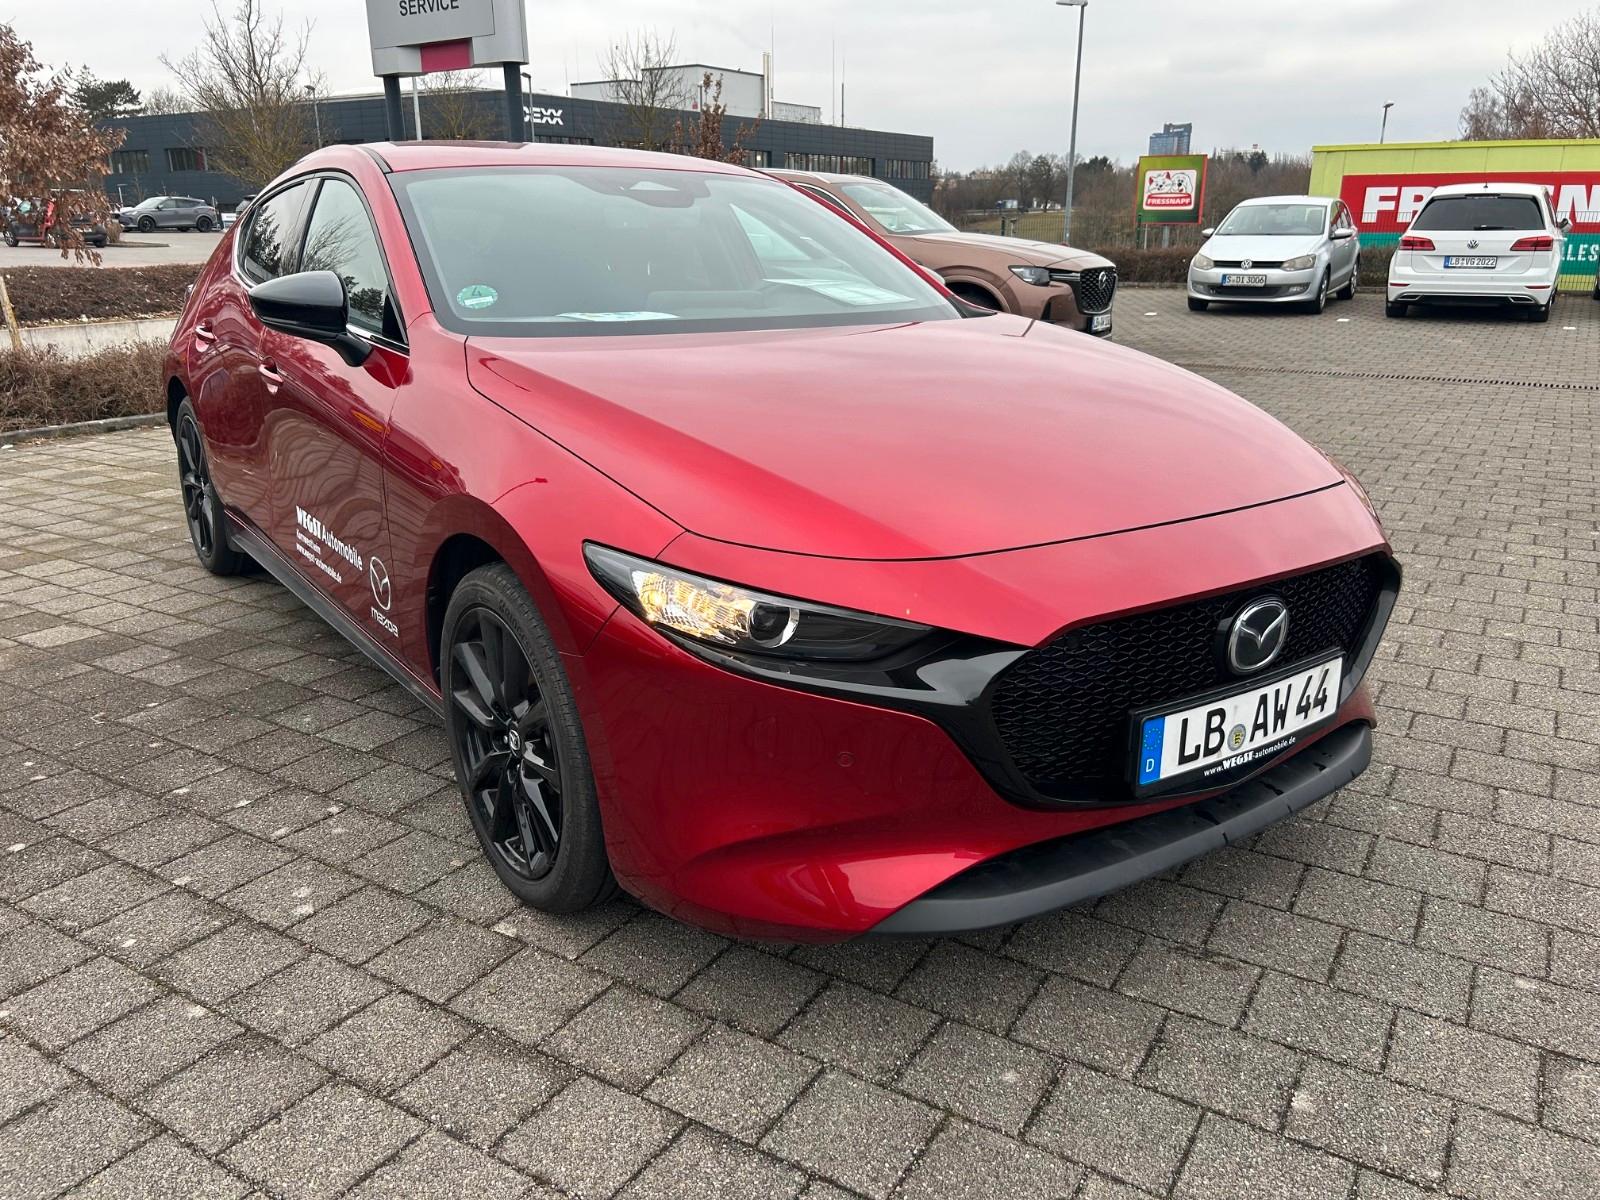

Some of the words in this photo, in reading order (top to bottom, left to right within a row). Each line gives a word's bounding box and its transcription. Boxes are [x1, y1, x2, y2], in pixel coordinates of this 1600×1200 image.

[399, 0, 459, 16] SERVICE
[1450, 257, 1460, 265] LB
[1465, 257, 1475, 265] VG
[1476, 257, 1496, 266] 2022
[1227, 275, 1232, 283] S
[1246, 276, 1265, 284] 3006
[471, 286, 482, 297] 4
[321, 525, 363, 571] Automobile
[371, 606, 399, 638] mazda
[1178, 708, 1227, 765] LB
[1249, 684, 1292, 743] AW
[1296, 668, 1329, 720] 44
[1203, 736, 1297, 777] www.WEGST-automobile.de
[1145, 758, 1155, 773] D
